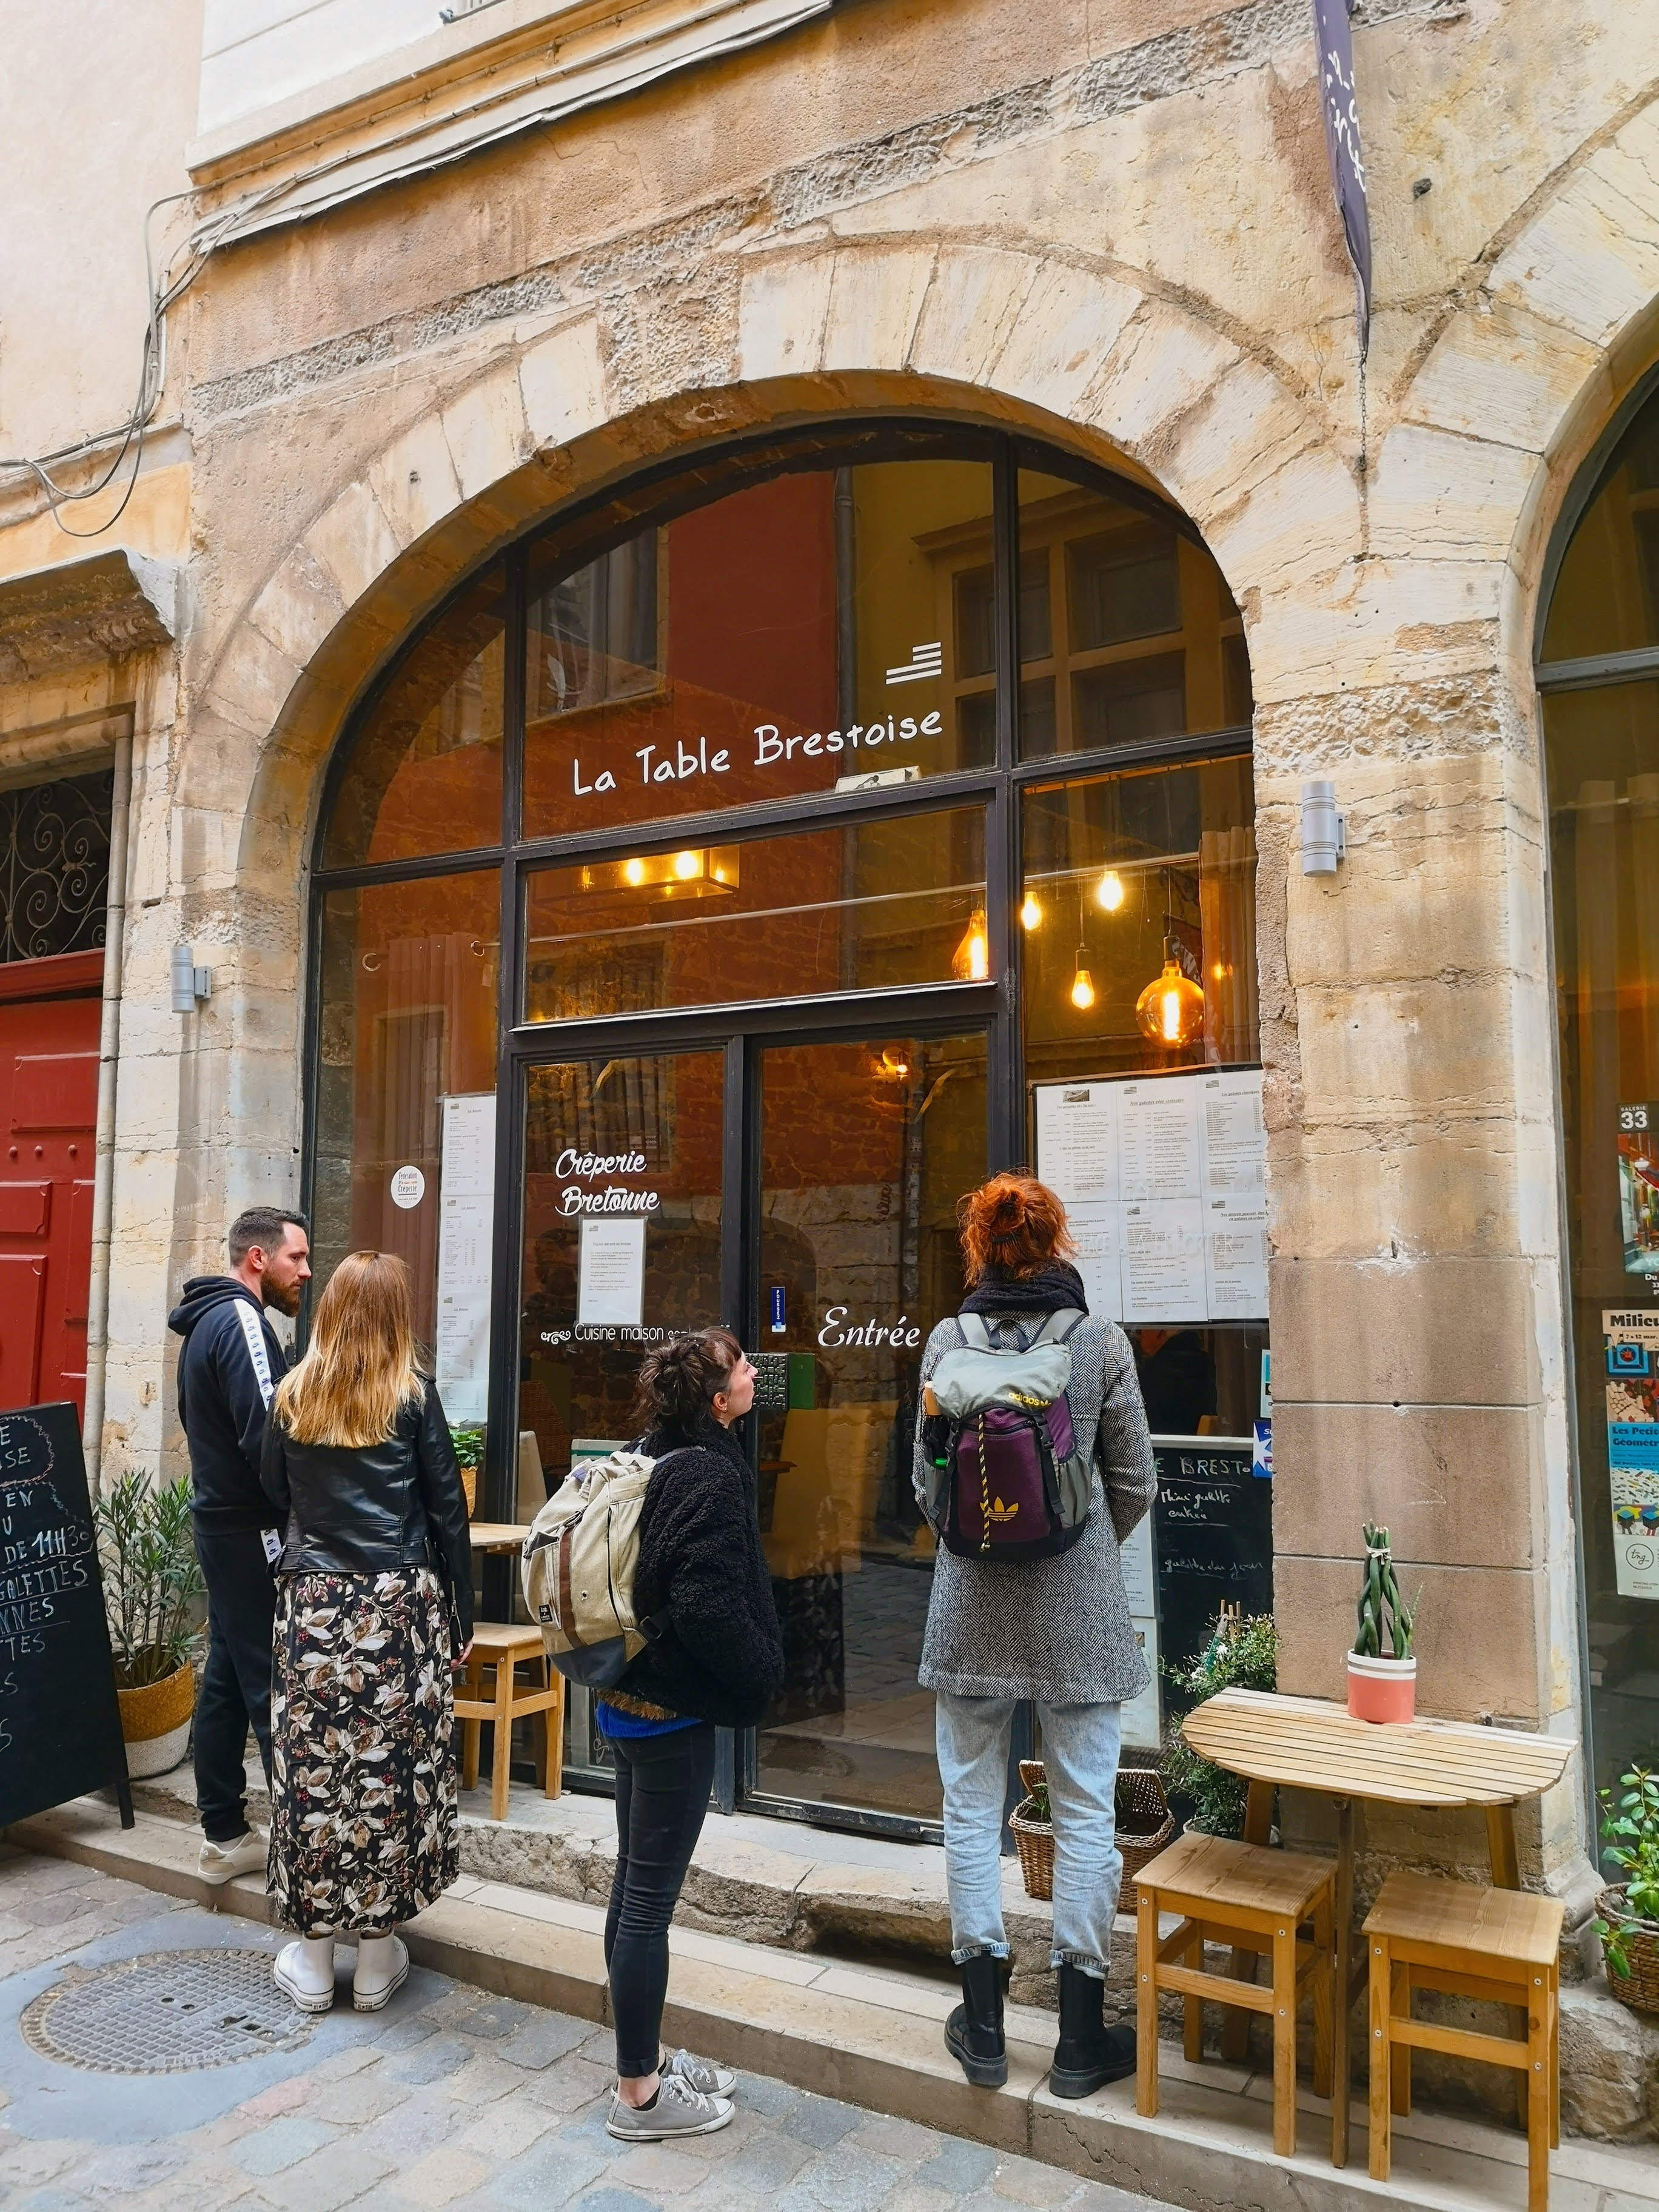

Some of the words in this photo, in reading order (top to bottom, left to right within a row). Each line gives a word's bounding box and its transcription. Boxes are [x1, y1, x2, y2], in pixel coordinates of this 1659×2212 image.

[573, 757, 617, 796] La
[635, 736, 731, 785] Table
[752, 709, 943, 766] Brestoise
[1621, 1110, 1647, 1129] 33
[555, 1148, 647, 1183] Crêperie
[398, 1184, 418, 1193] Crêperie
[555, 1185, 661, 1216] Bretonne
[575, 1322, 616, 1340] Cuisine
[621, 1325, 664, 1340] maison
[818, 1306, 920, 1347] Entrée
[1008, 1392, 1039, 1406] adidas
[1612, 1426, 1629, 1435] Les
[1632, 1427, 1659, 1435] Petit
[0, 1447, 31, 1470] SE
[1179, 1456, 1253, 1476] BRESTO
[5, 1490, 33, 1507] EN
[4, 1541, 27, 1564] DE
[31, 1526, 89, 1558] 11H30
[0, 1560, 88, 1601] GALETTES
[0, 1633, 45, 1661] TES
